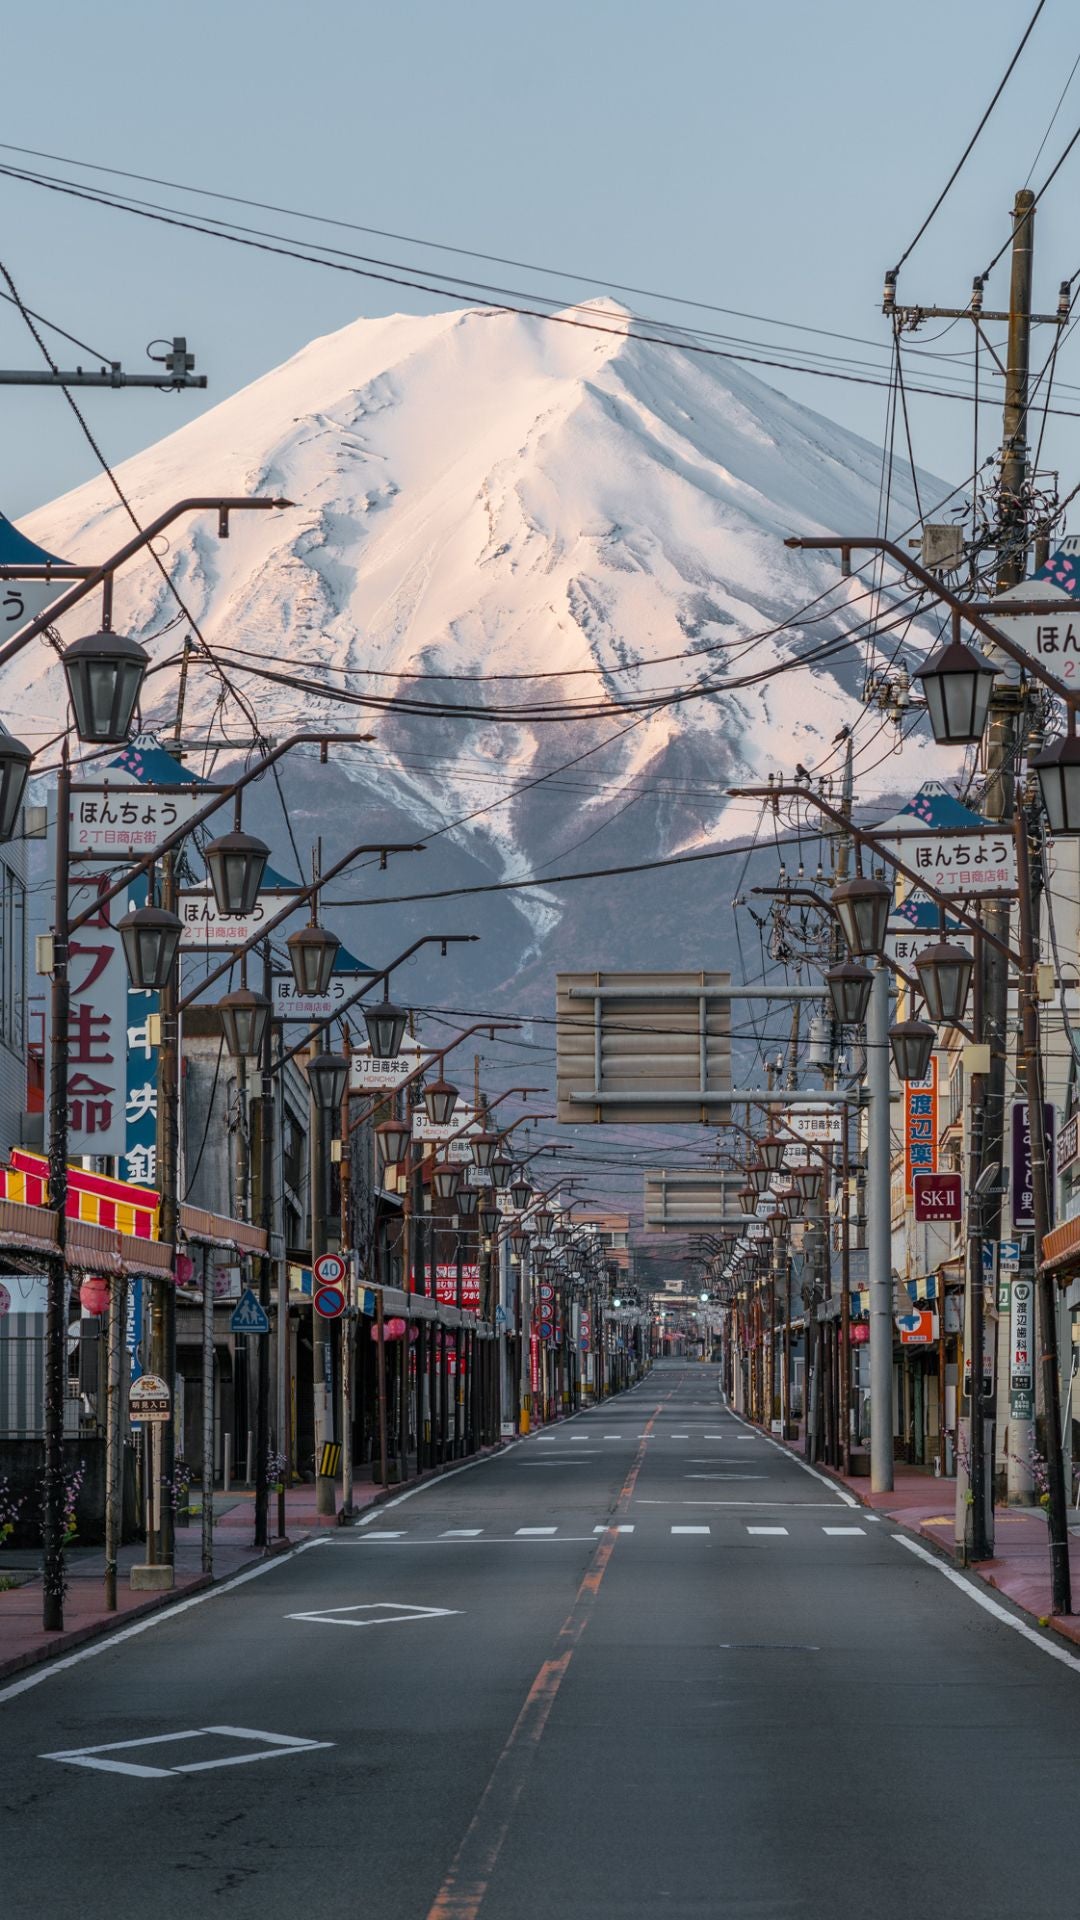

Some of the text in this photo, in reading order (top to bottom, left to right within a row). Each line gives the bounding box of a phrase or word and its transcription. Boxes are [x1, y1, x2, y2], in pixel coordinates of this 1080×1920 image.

[79, 801, 178, 826] ほんちょう
[79, 829, 158, 845] 2丁目商店街
[915, 841, 1008, 868] ほんちょう
[935, 868, 1009, 885] 2丁目商店街
[183, 926, 248, 938] 2丁目商店街
[354, 1059, 410, 1073] 3丁目商栄会
[909, 1094, 933, 1178] 渡辺薬
[920, 1190, 956, 1207] SK-II
[321, 1262, 339, 1278] 40
